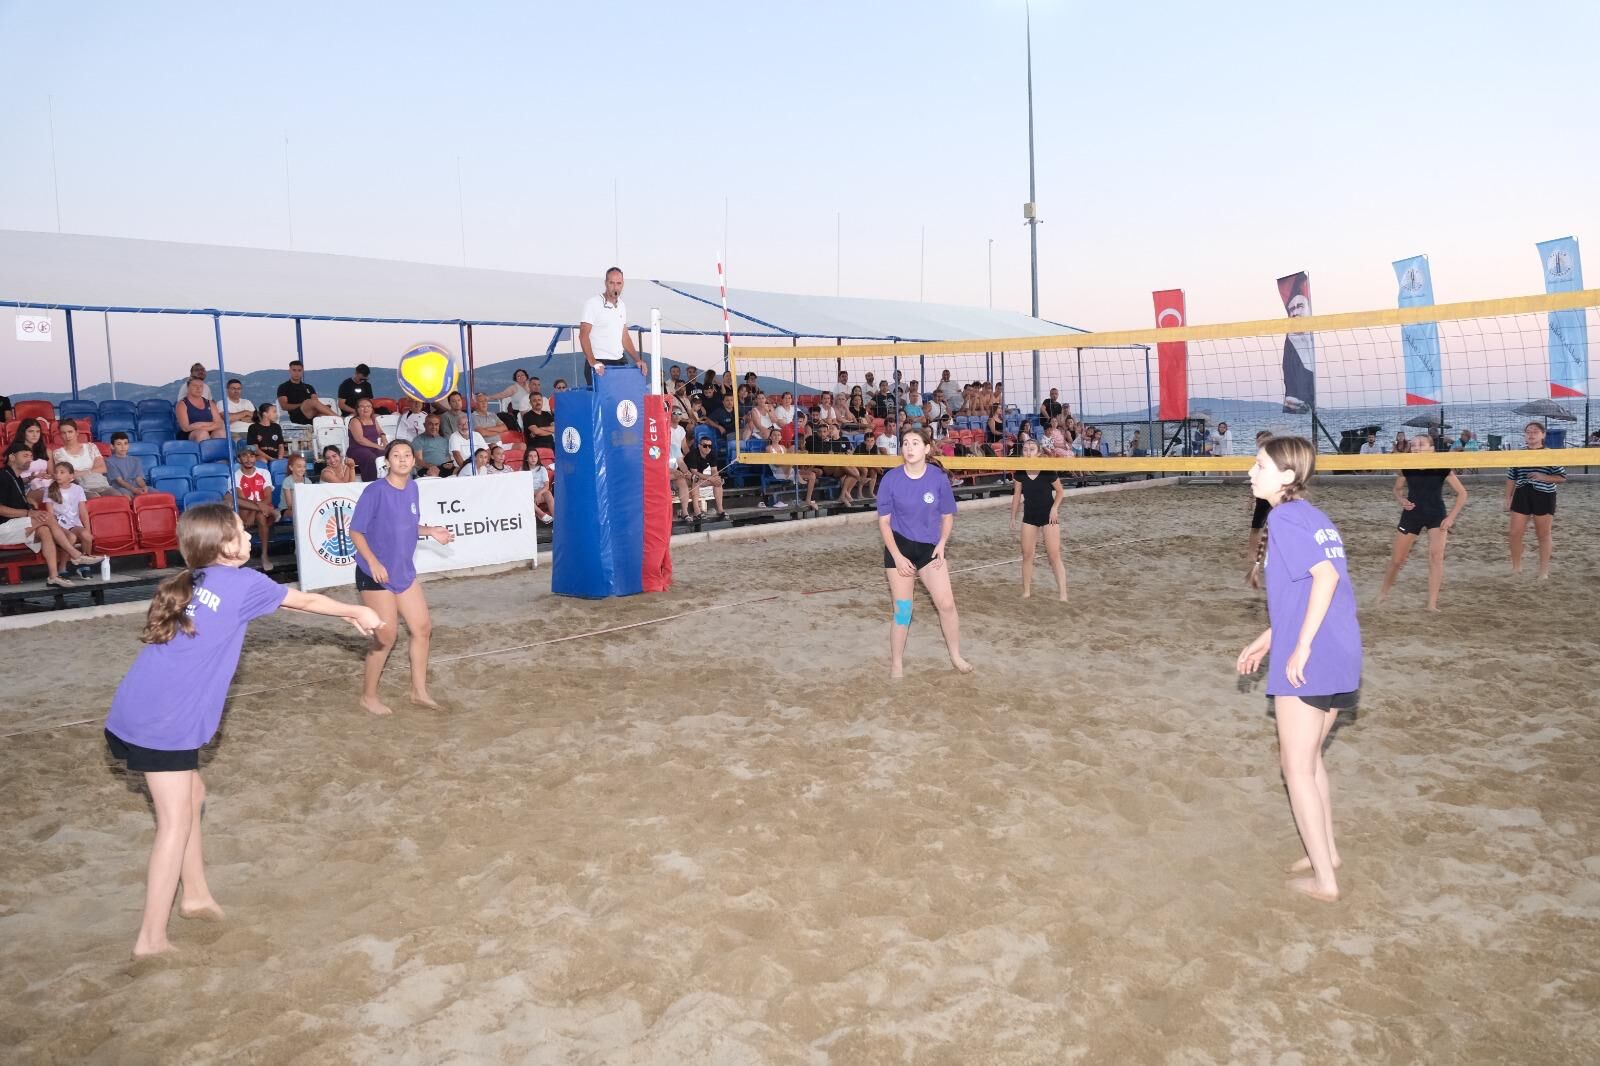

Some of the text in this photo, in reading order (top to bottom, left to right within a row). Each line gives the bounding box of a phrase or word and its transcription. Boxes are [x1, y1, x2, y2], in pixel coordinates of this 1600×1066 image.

[649, 417, 658, 441] CEV
[437, 499, 465, 514] T.C.
[434, 513, 522, 538] ELEDİYESİ
